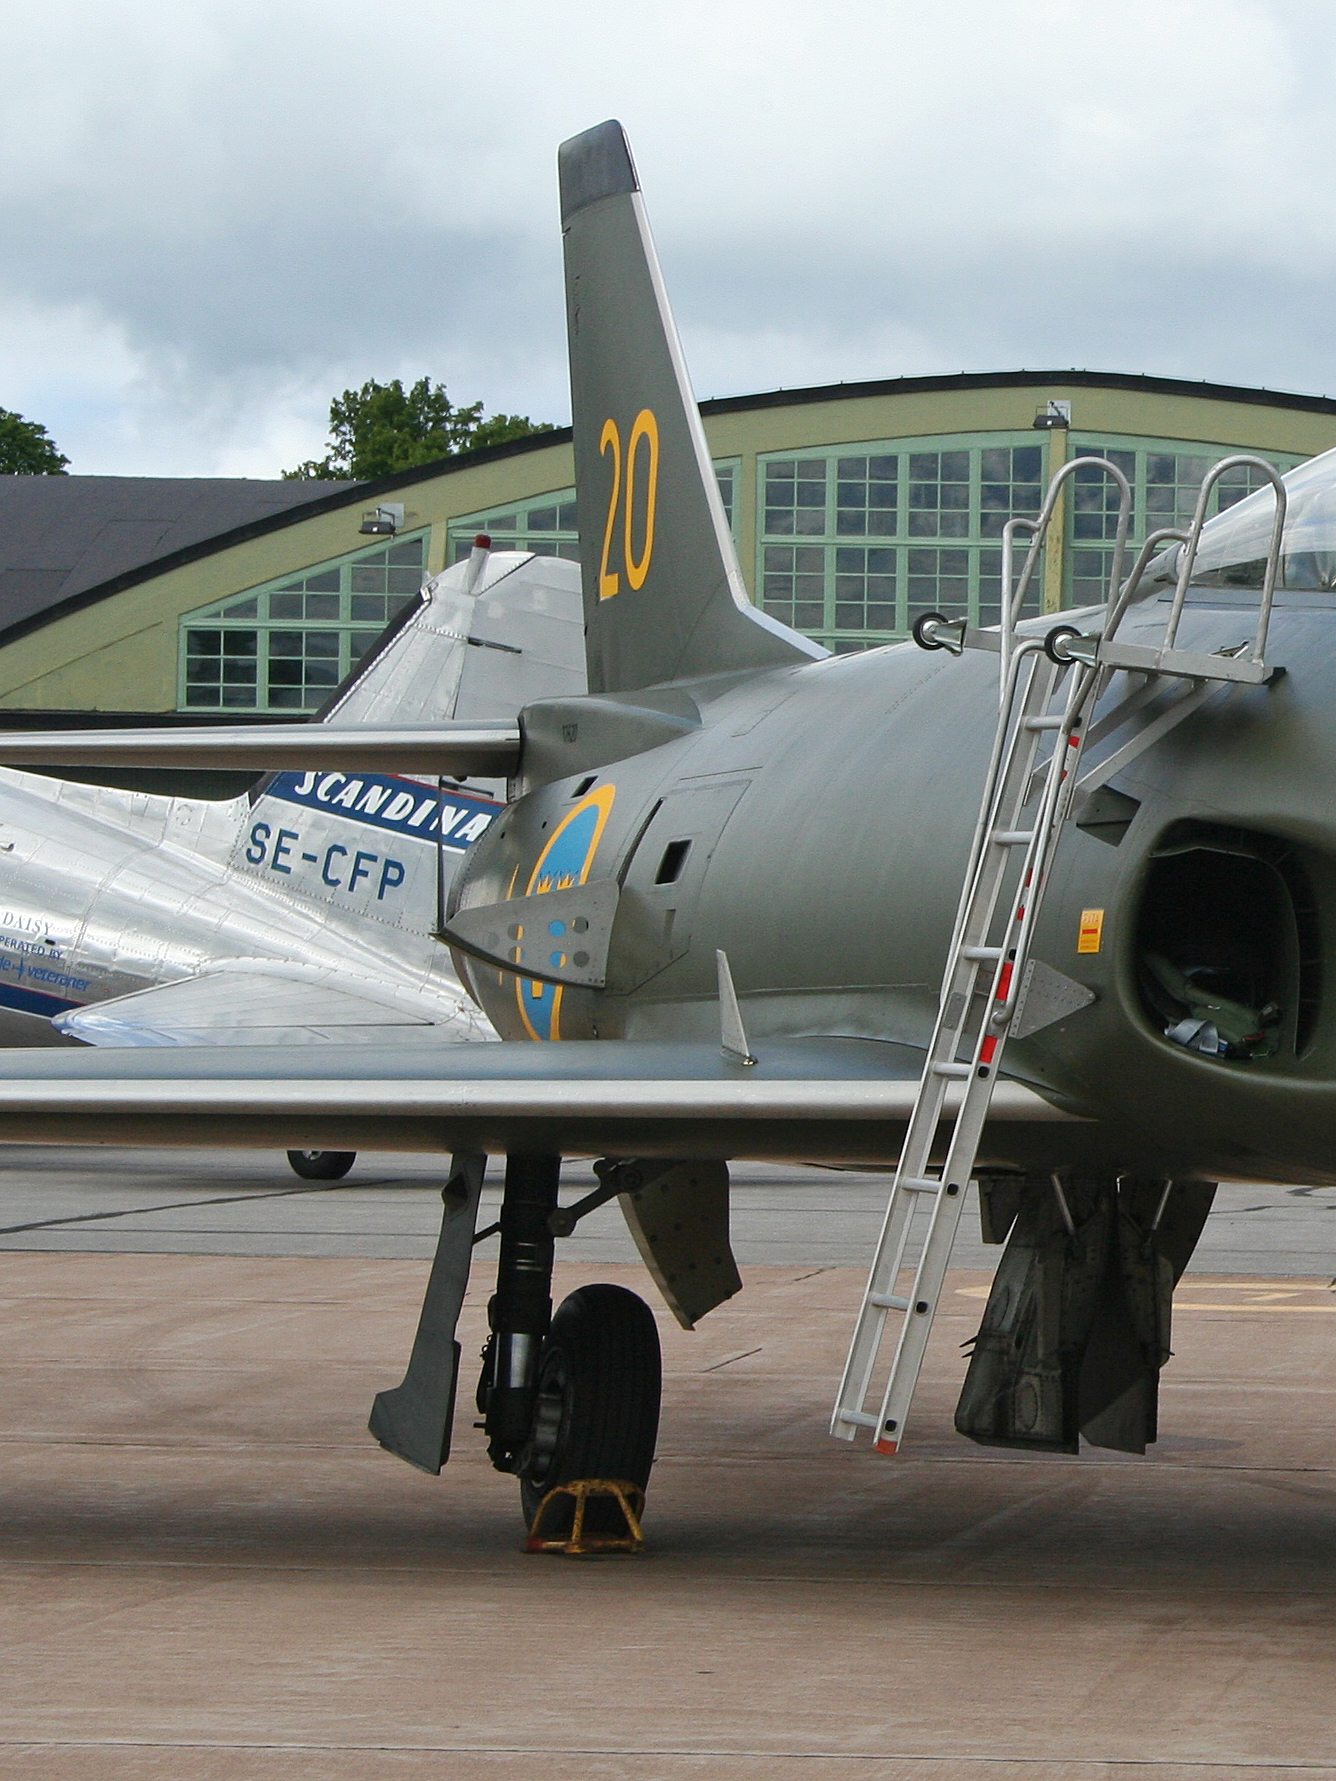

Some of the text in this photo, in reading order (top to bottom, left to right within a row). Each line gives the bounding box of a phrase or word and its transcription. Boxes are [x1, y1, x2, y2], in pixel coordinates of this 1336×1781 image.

[600, 409, 659, 601] 20
[246, 822, 405, 900] SE-CFP
[3, 911, 52, 936] DAISY
[49, 948, 63, 960] BY
